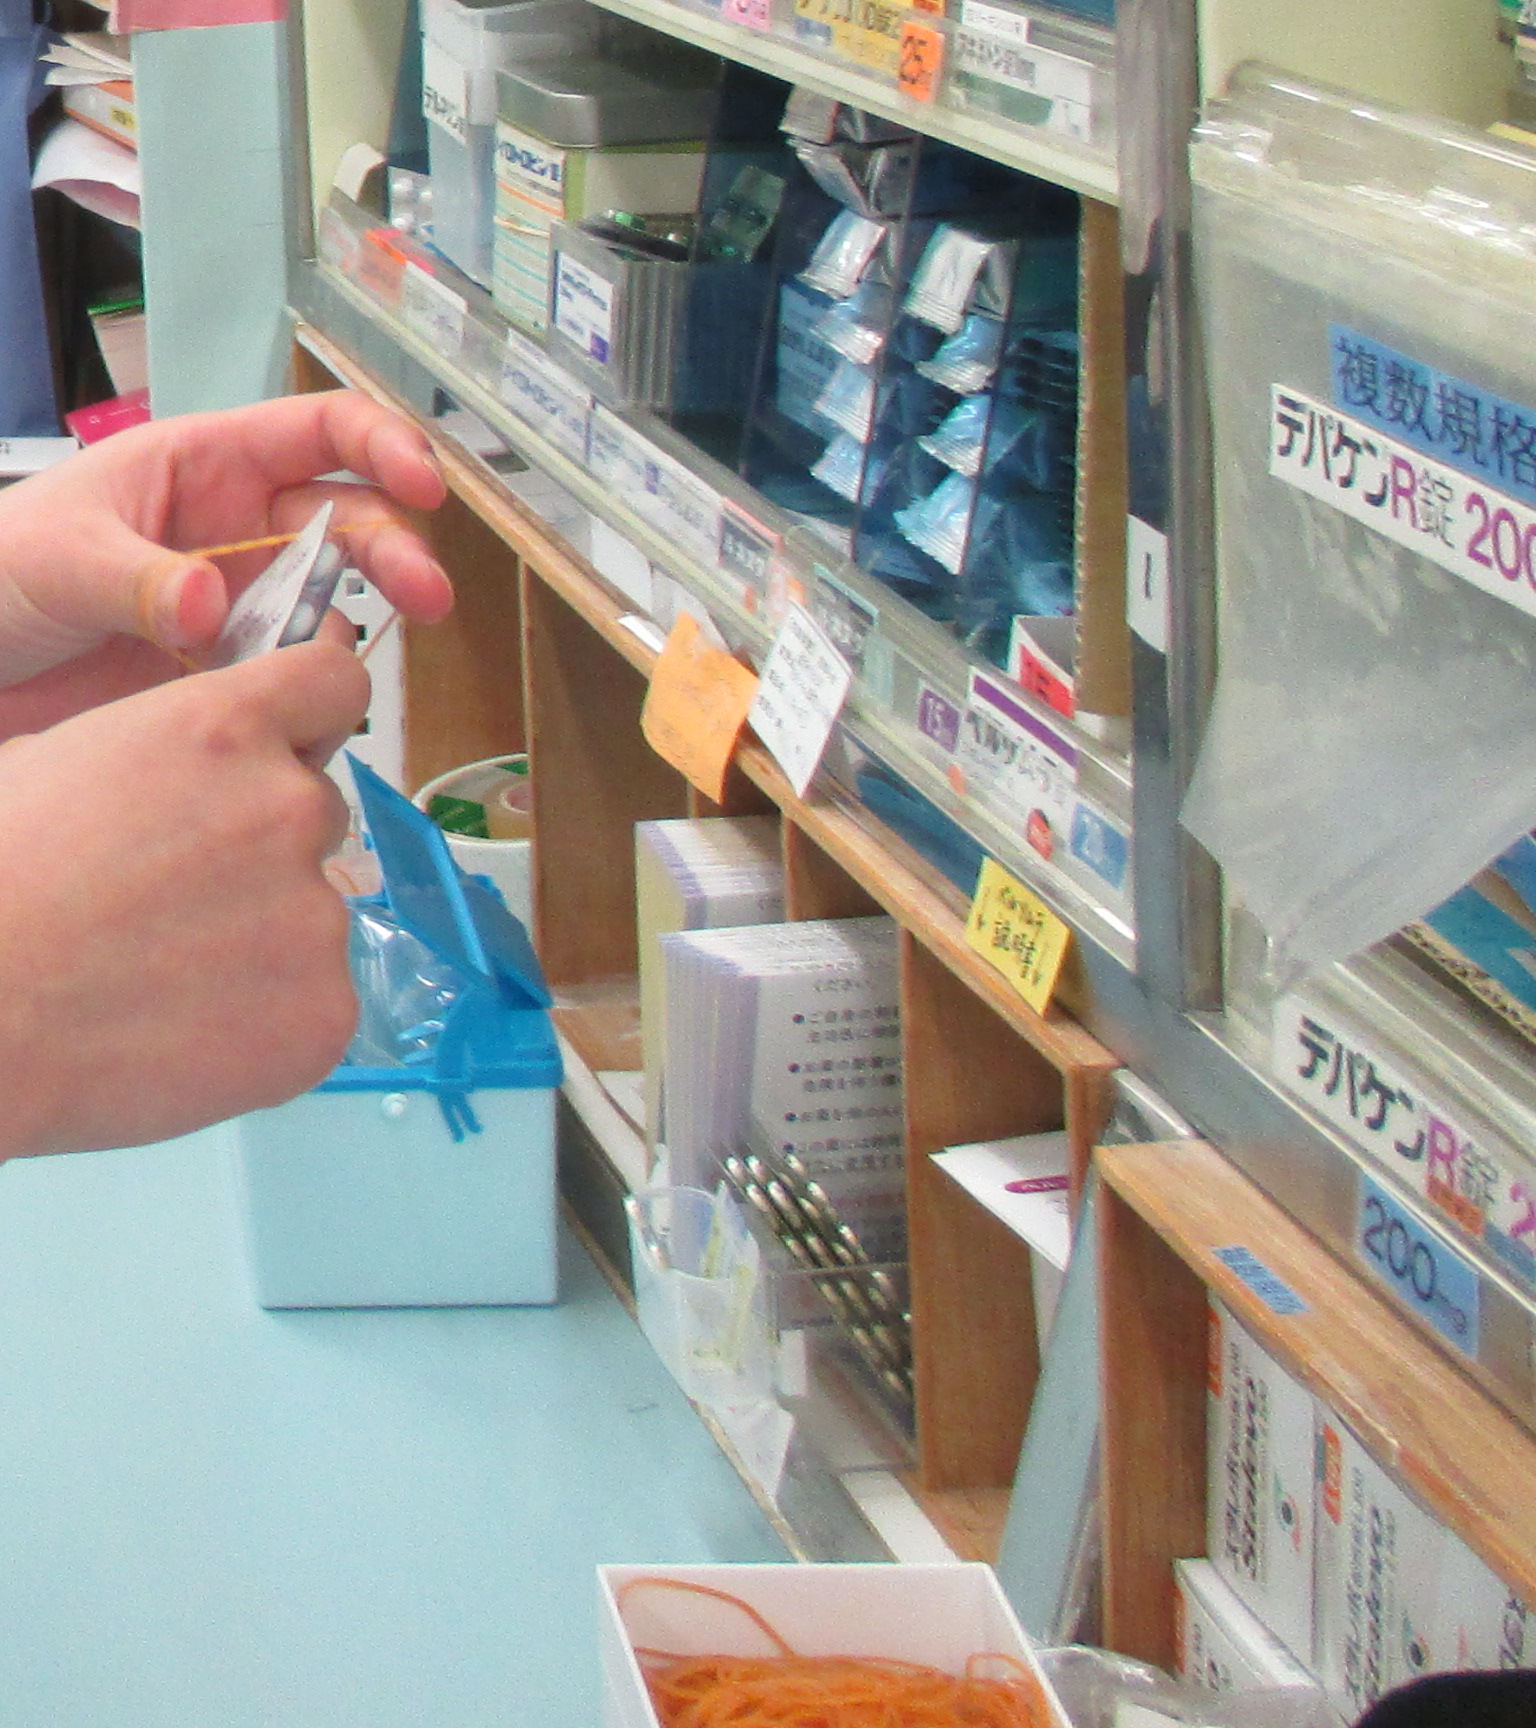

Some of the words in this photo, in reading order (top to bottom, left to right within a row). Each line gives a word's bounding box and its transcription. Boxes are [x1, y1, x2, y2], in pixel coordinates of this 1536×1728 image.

[1276, 393, 1456, 550] デパケンR錠
[1333, 334, 1536, 490] 複数規格
[1296, 1014, 1501, 1205] デパケンR錠
